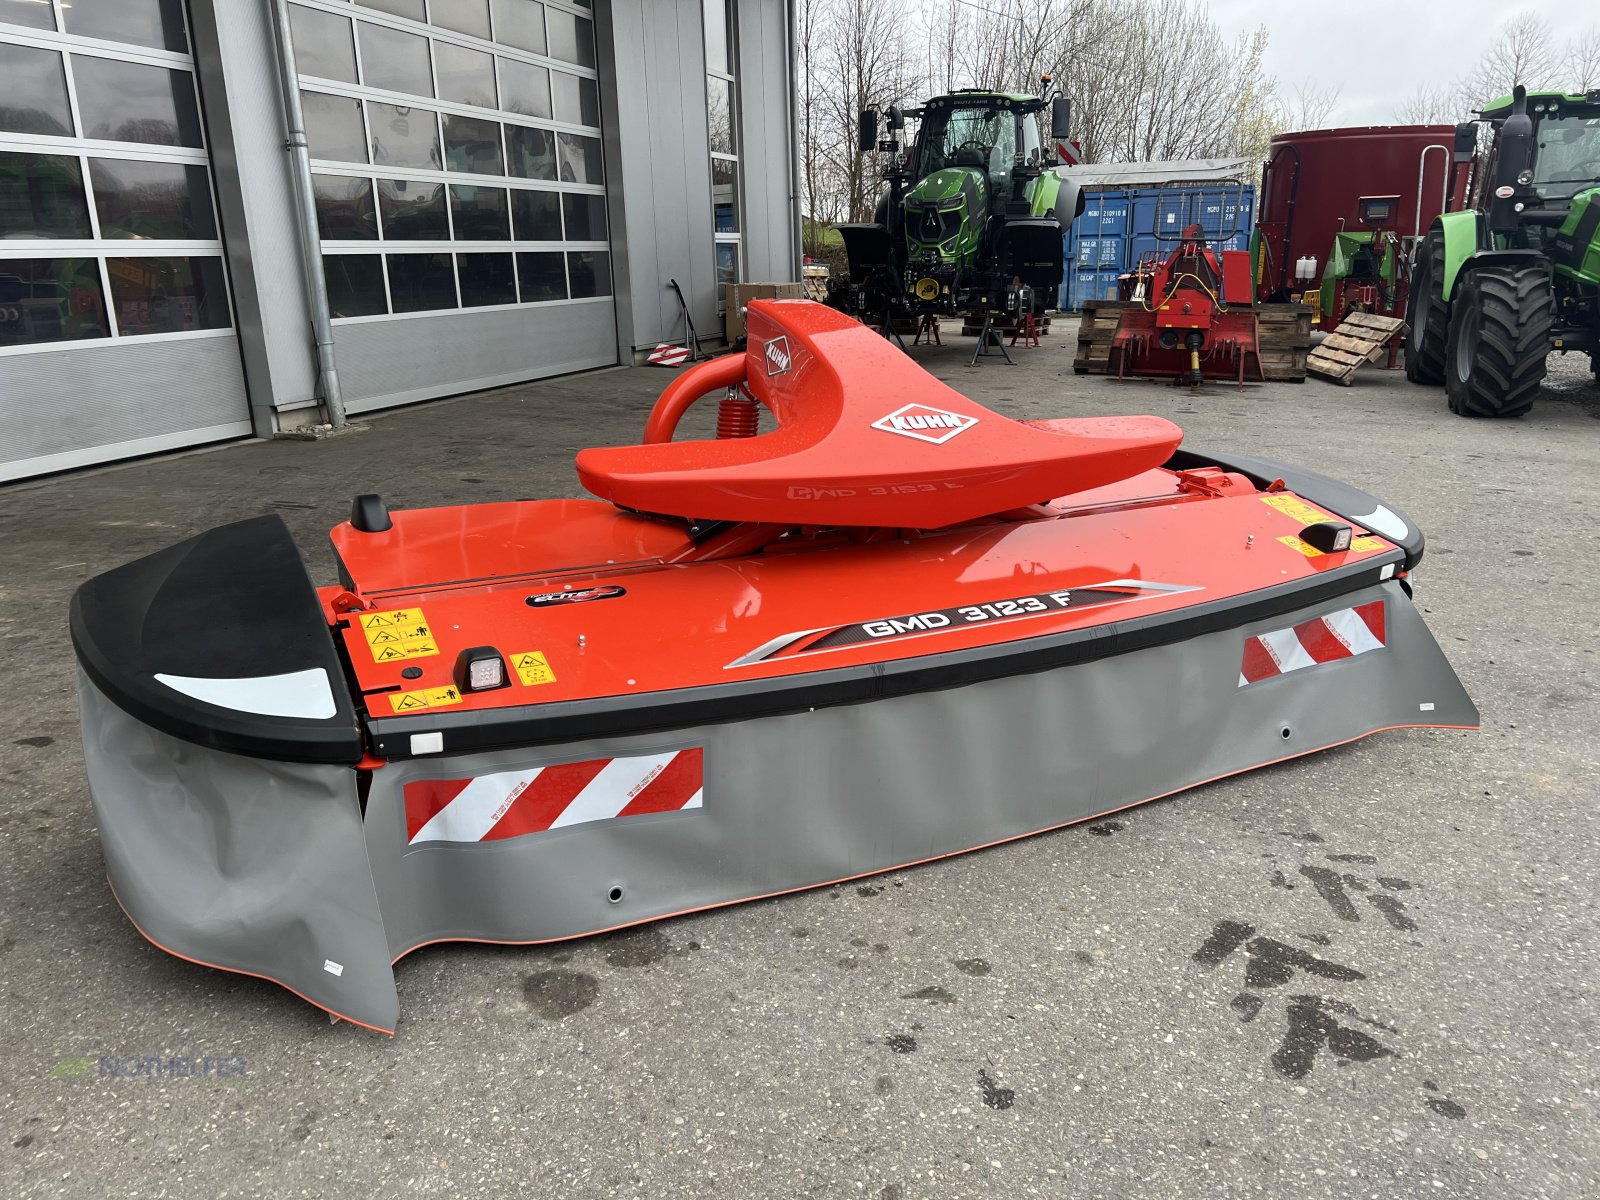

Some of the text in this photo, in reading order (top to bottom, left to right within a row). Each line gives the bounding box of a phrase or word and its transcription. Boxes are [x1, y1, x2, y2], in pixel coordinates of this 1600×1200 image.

[766, 342, 790, 371] KUHN
[888, 414, 964, 431] KUHN
[861, 592, 1072, 638] GMD 3123 F
